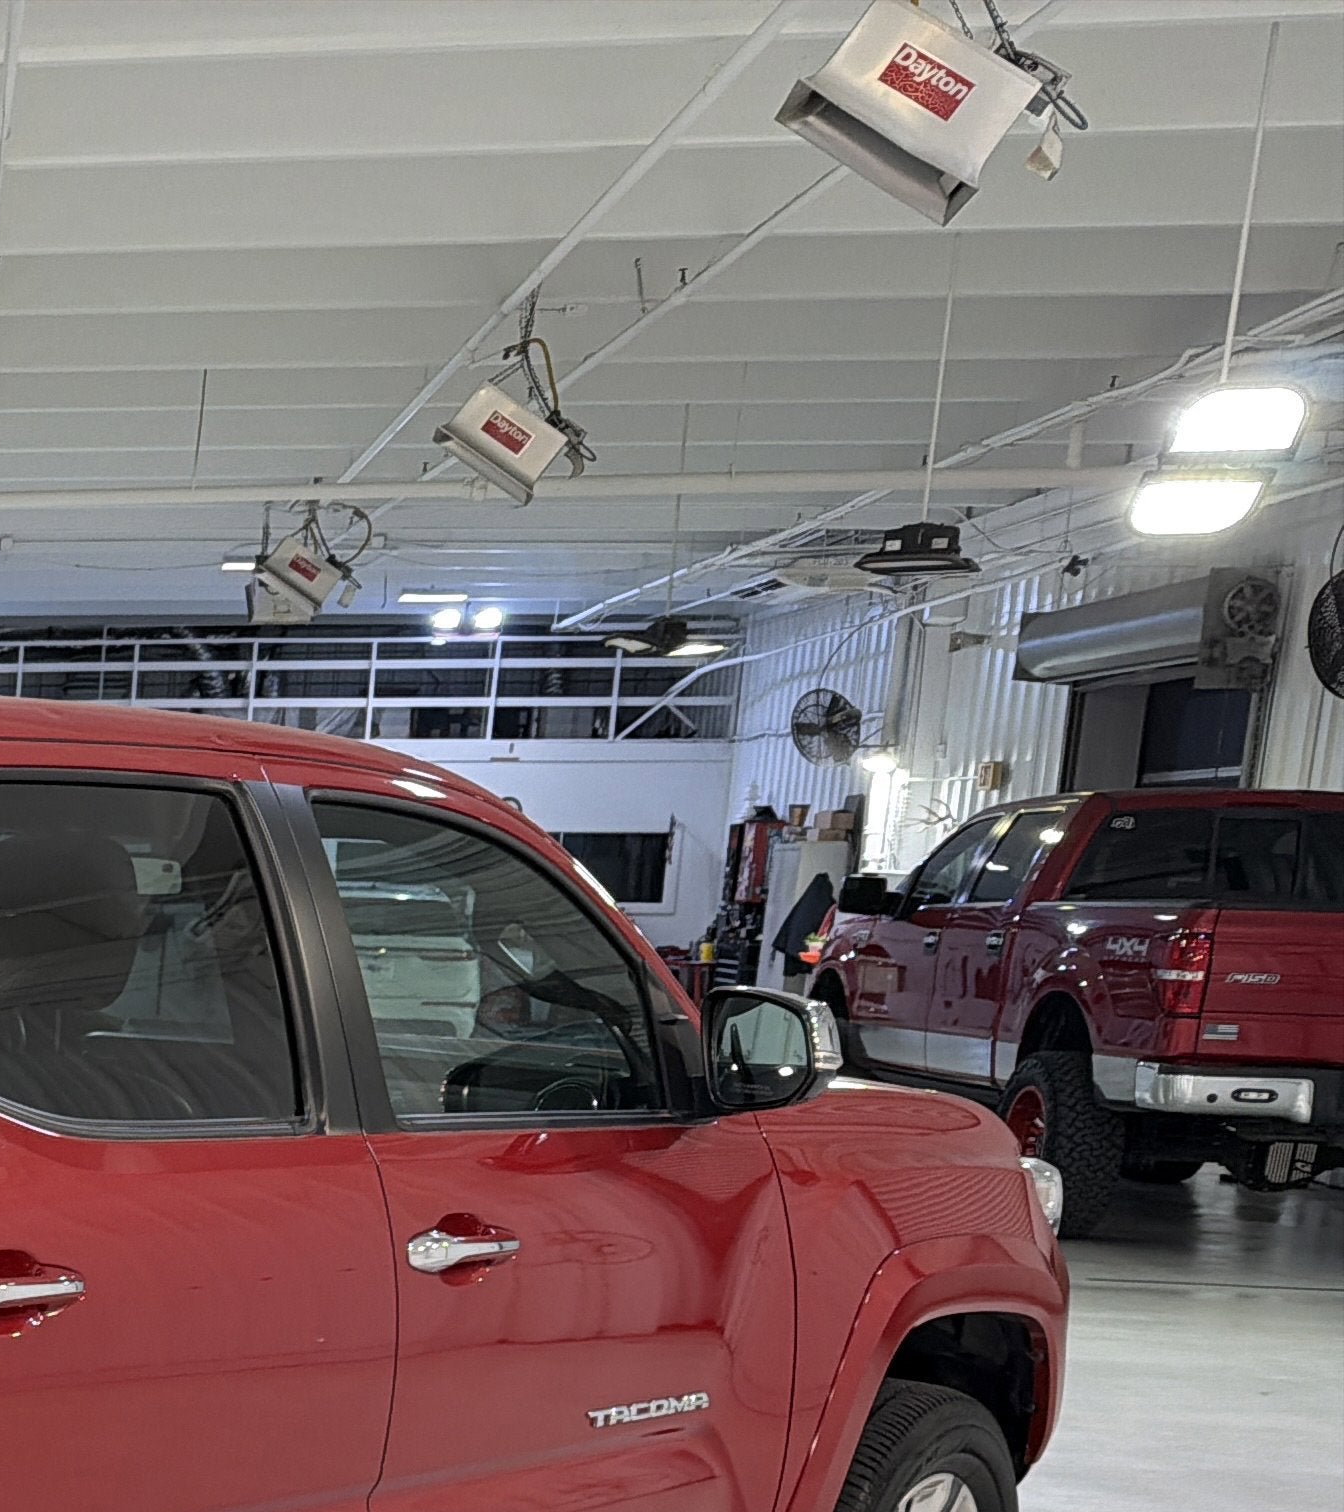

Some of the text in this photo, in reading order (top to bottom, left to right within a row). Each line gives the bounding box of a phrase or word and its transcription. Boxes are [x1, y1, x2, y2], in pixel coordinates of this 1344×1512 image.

[894, 46, 969, 101] Dayton
[489, 412, 530, 444] Dayton
[587, 1391, 710, 1429] TACOMA
